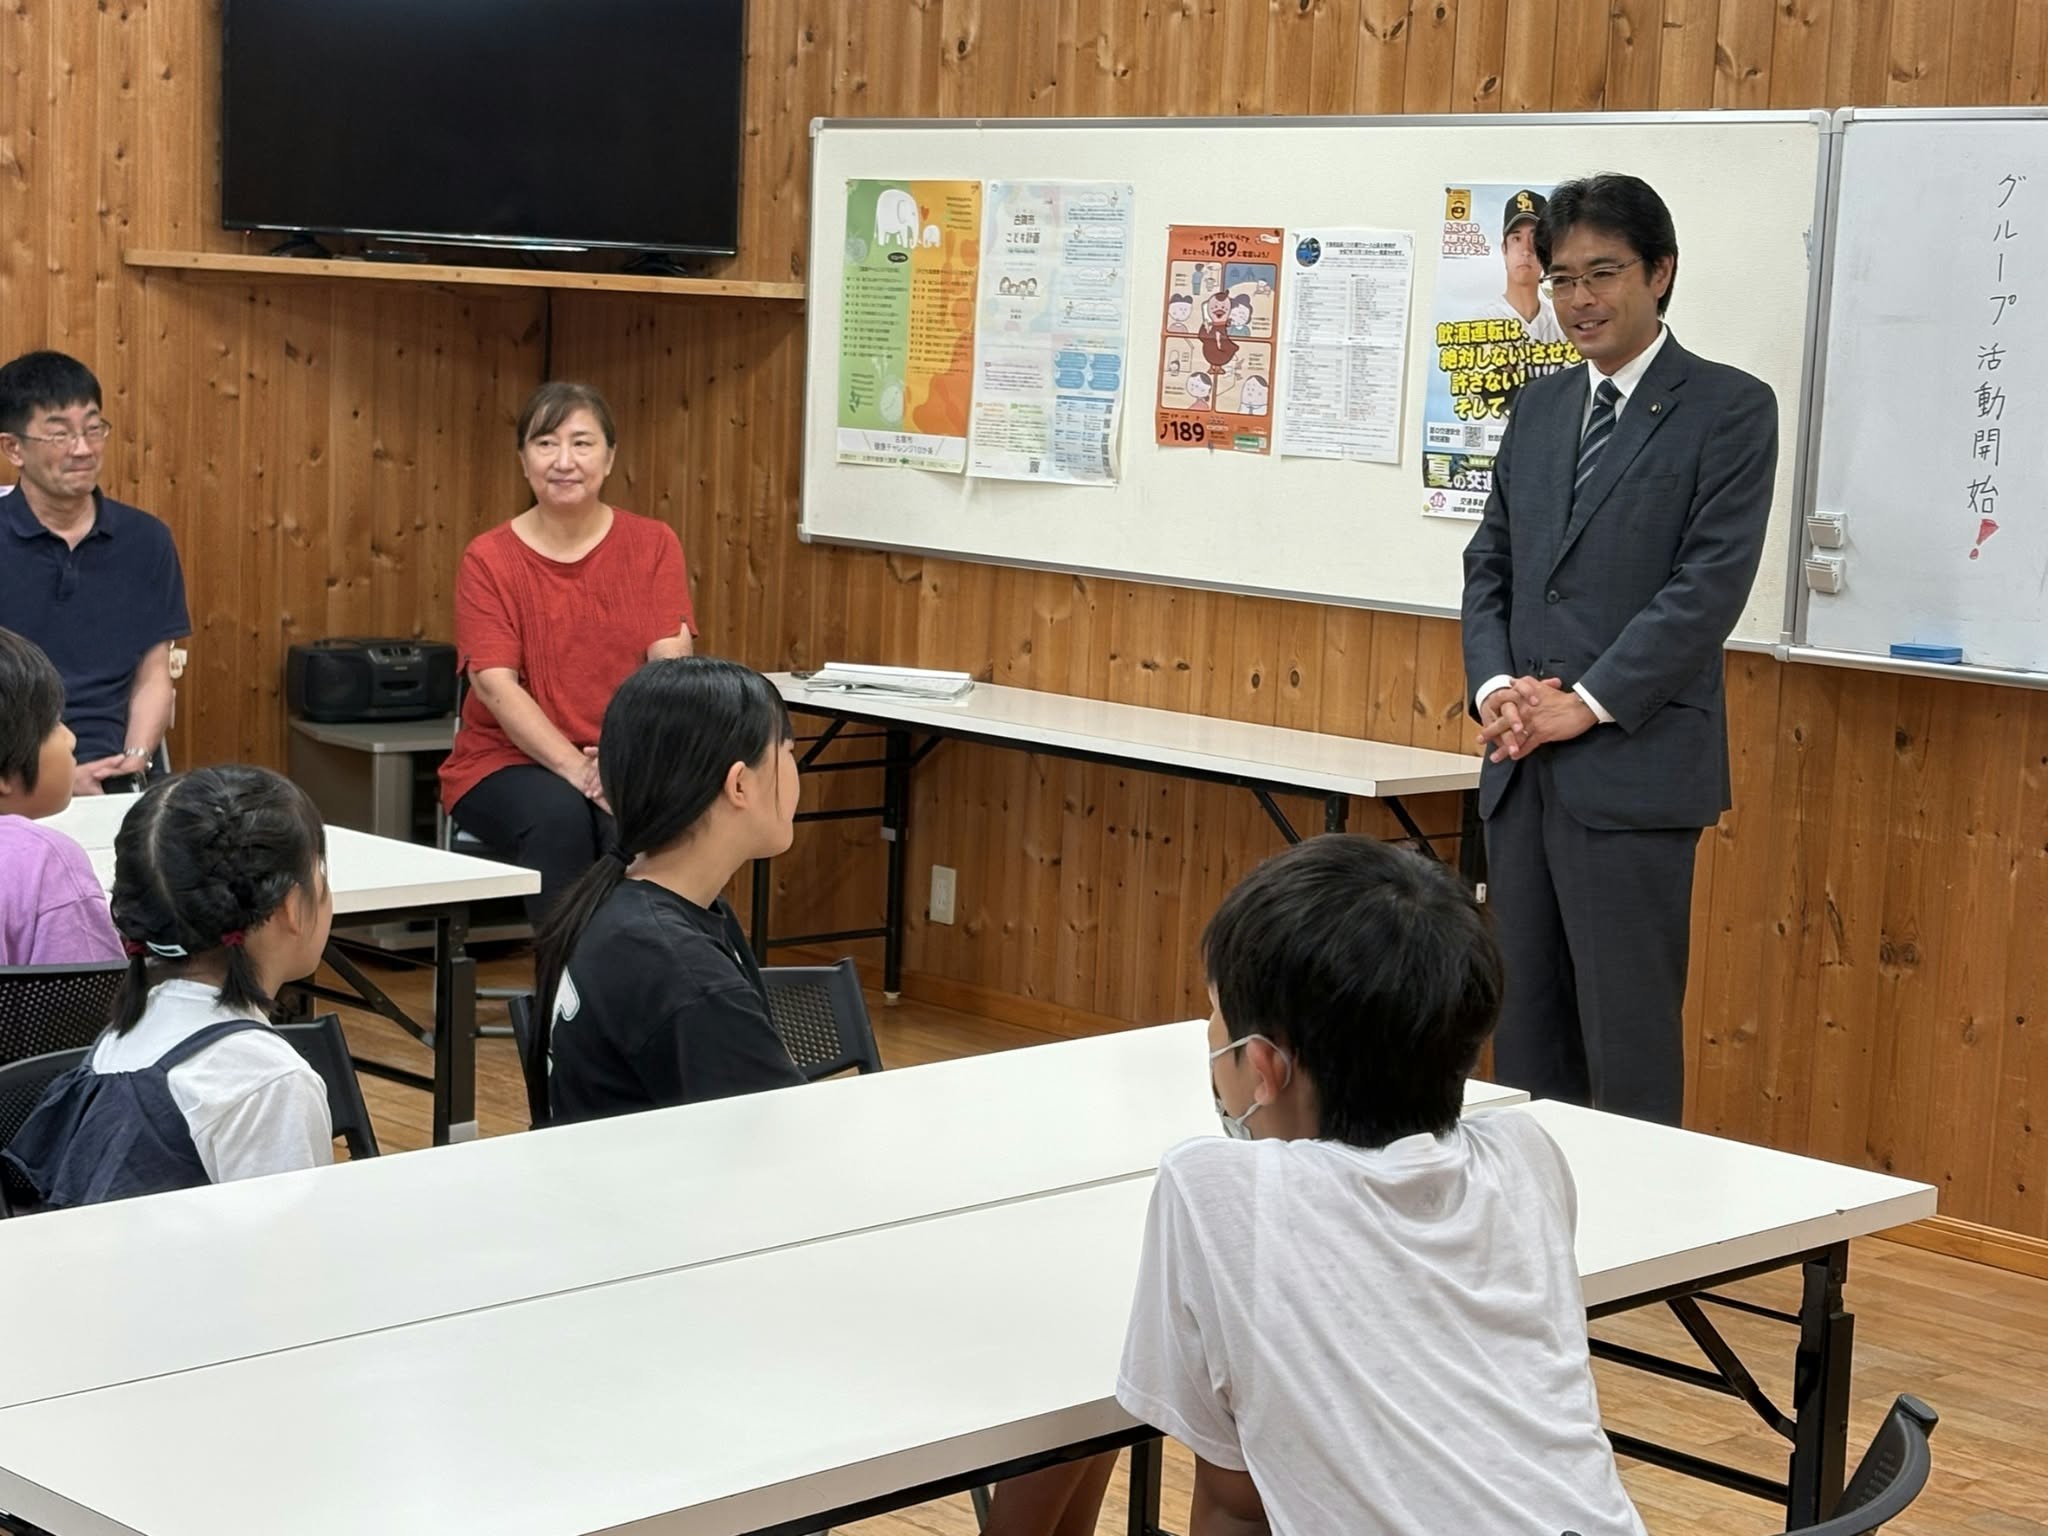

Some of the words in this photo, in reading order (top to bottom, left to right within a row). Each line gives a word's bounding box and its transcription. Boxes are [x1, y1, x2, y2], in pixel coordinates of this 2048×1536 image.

[1210, 240, 1238, 258] 189
[1437, 319, 1529, 346] 飲酒運転は、
[1450, 369, 1526, 396] 許さない!
[1170, 420, 1205, 442] 189
